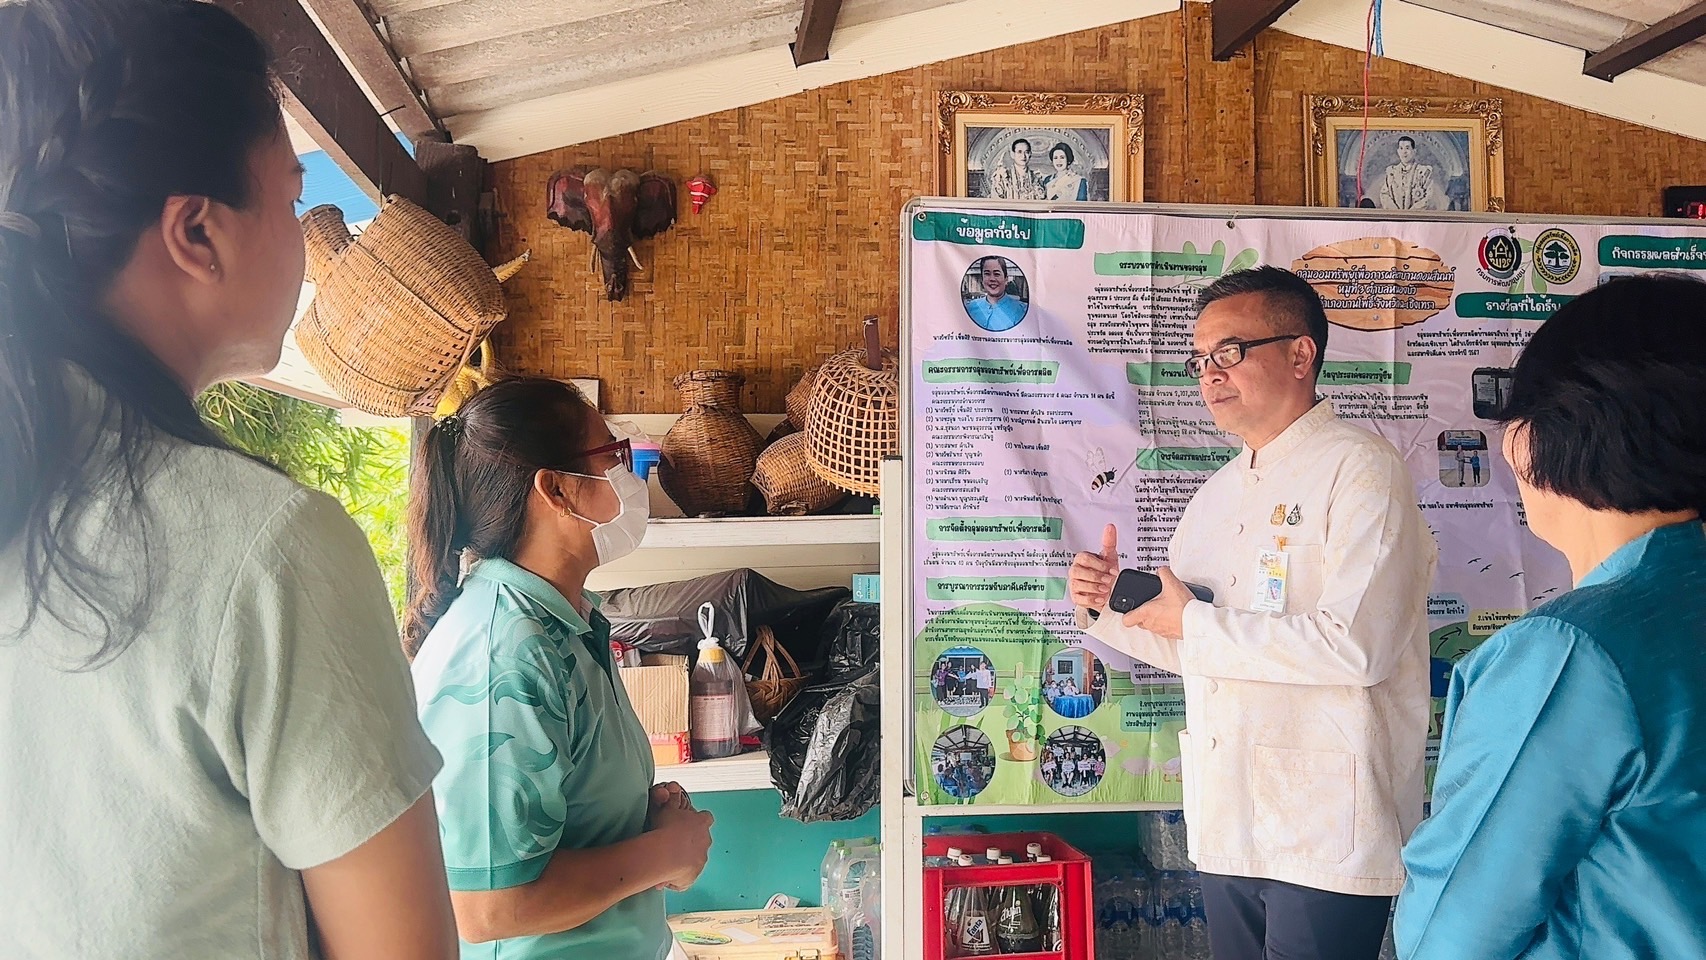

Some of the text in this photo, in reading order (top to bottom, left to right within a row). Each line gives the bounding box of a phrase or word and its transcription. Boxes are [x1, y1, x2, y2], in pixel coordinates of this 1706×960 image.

[956, 217, 1031, 244] ข้อมูลทั่วไป
[1476, 267, 1526, 287] กรมการพัฒนาชุมชน
[1320, 293, 1375, 310] ำเภอบ้านโพธิ์
[1486, 294, 1561, 312] รางวัลที่ได้รับ
